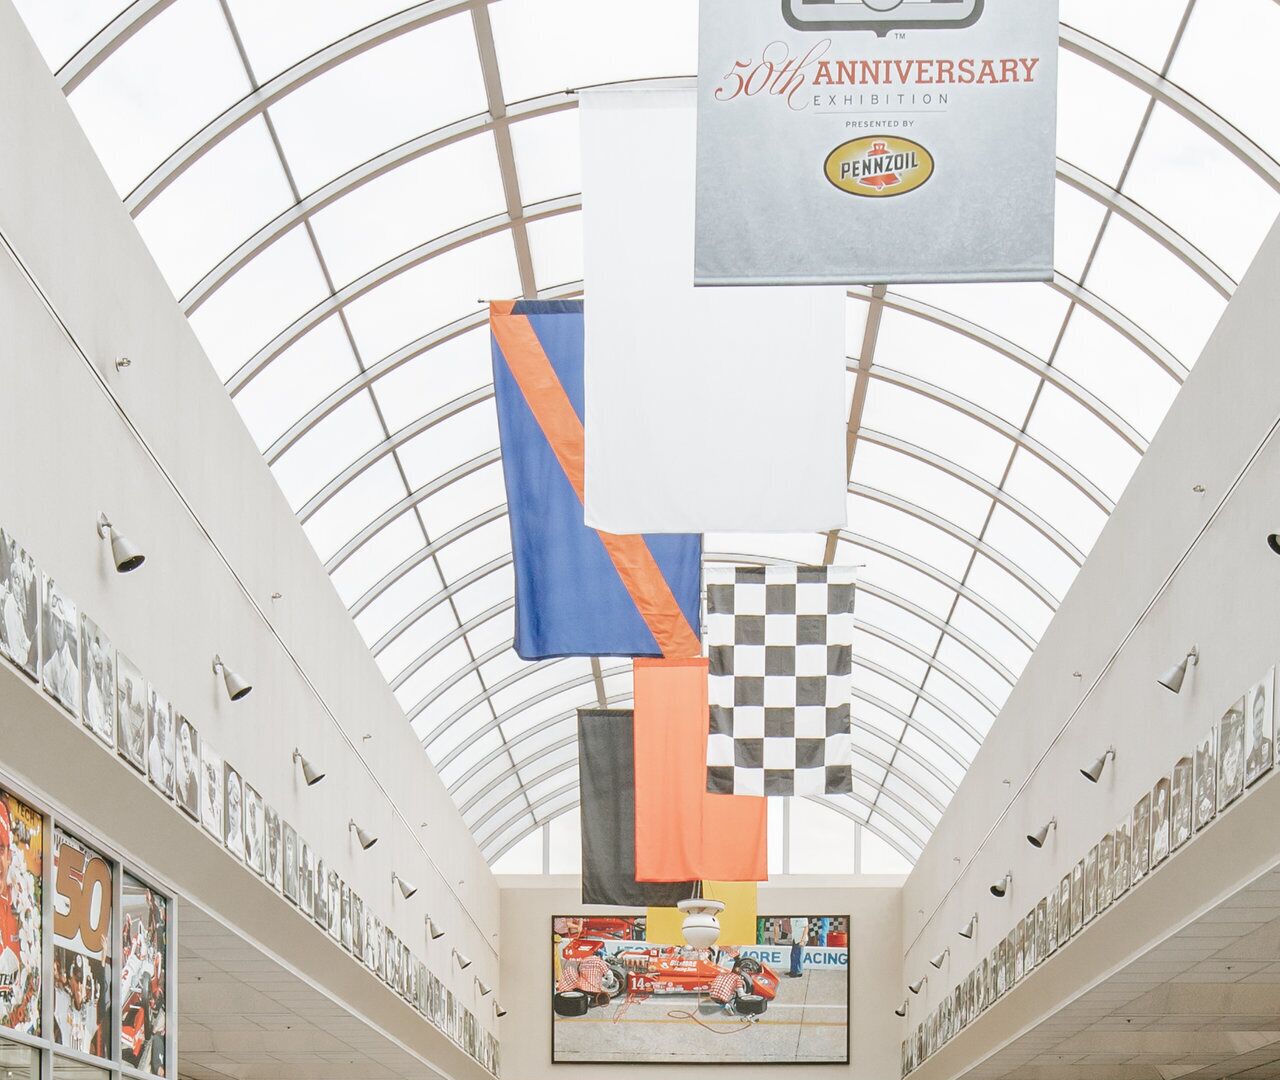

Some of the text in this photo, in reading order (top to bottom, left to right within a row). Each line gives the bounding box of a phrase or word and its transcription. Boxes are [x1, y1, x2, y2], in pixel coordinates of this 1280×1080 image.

[714, 38, 1040, 112] 50th ANNIVERSARY
[813, 93, 948, 107] EXHIBITION
[845, 120, 915, 129] PRESENTED BY
[840, 151, 919, 180] PENNZOIL
[54, 842, 112, 953] 50
[803, 952, 849, 964] ACING
[631, 976, 645, 990] 14
